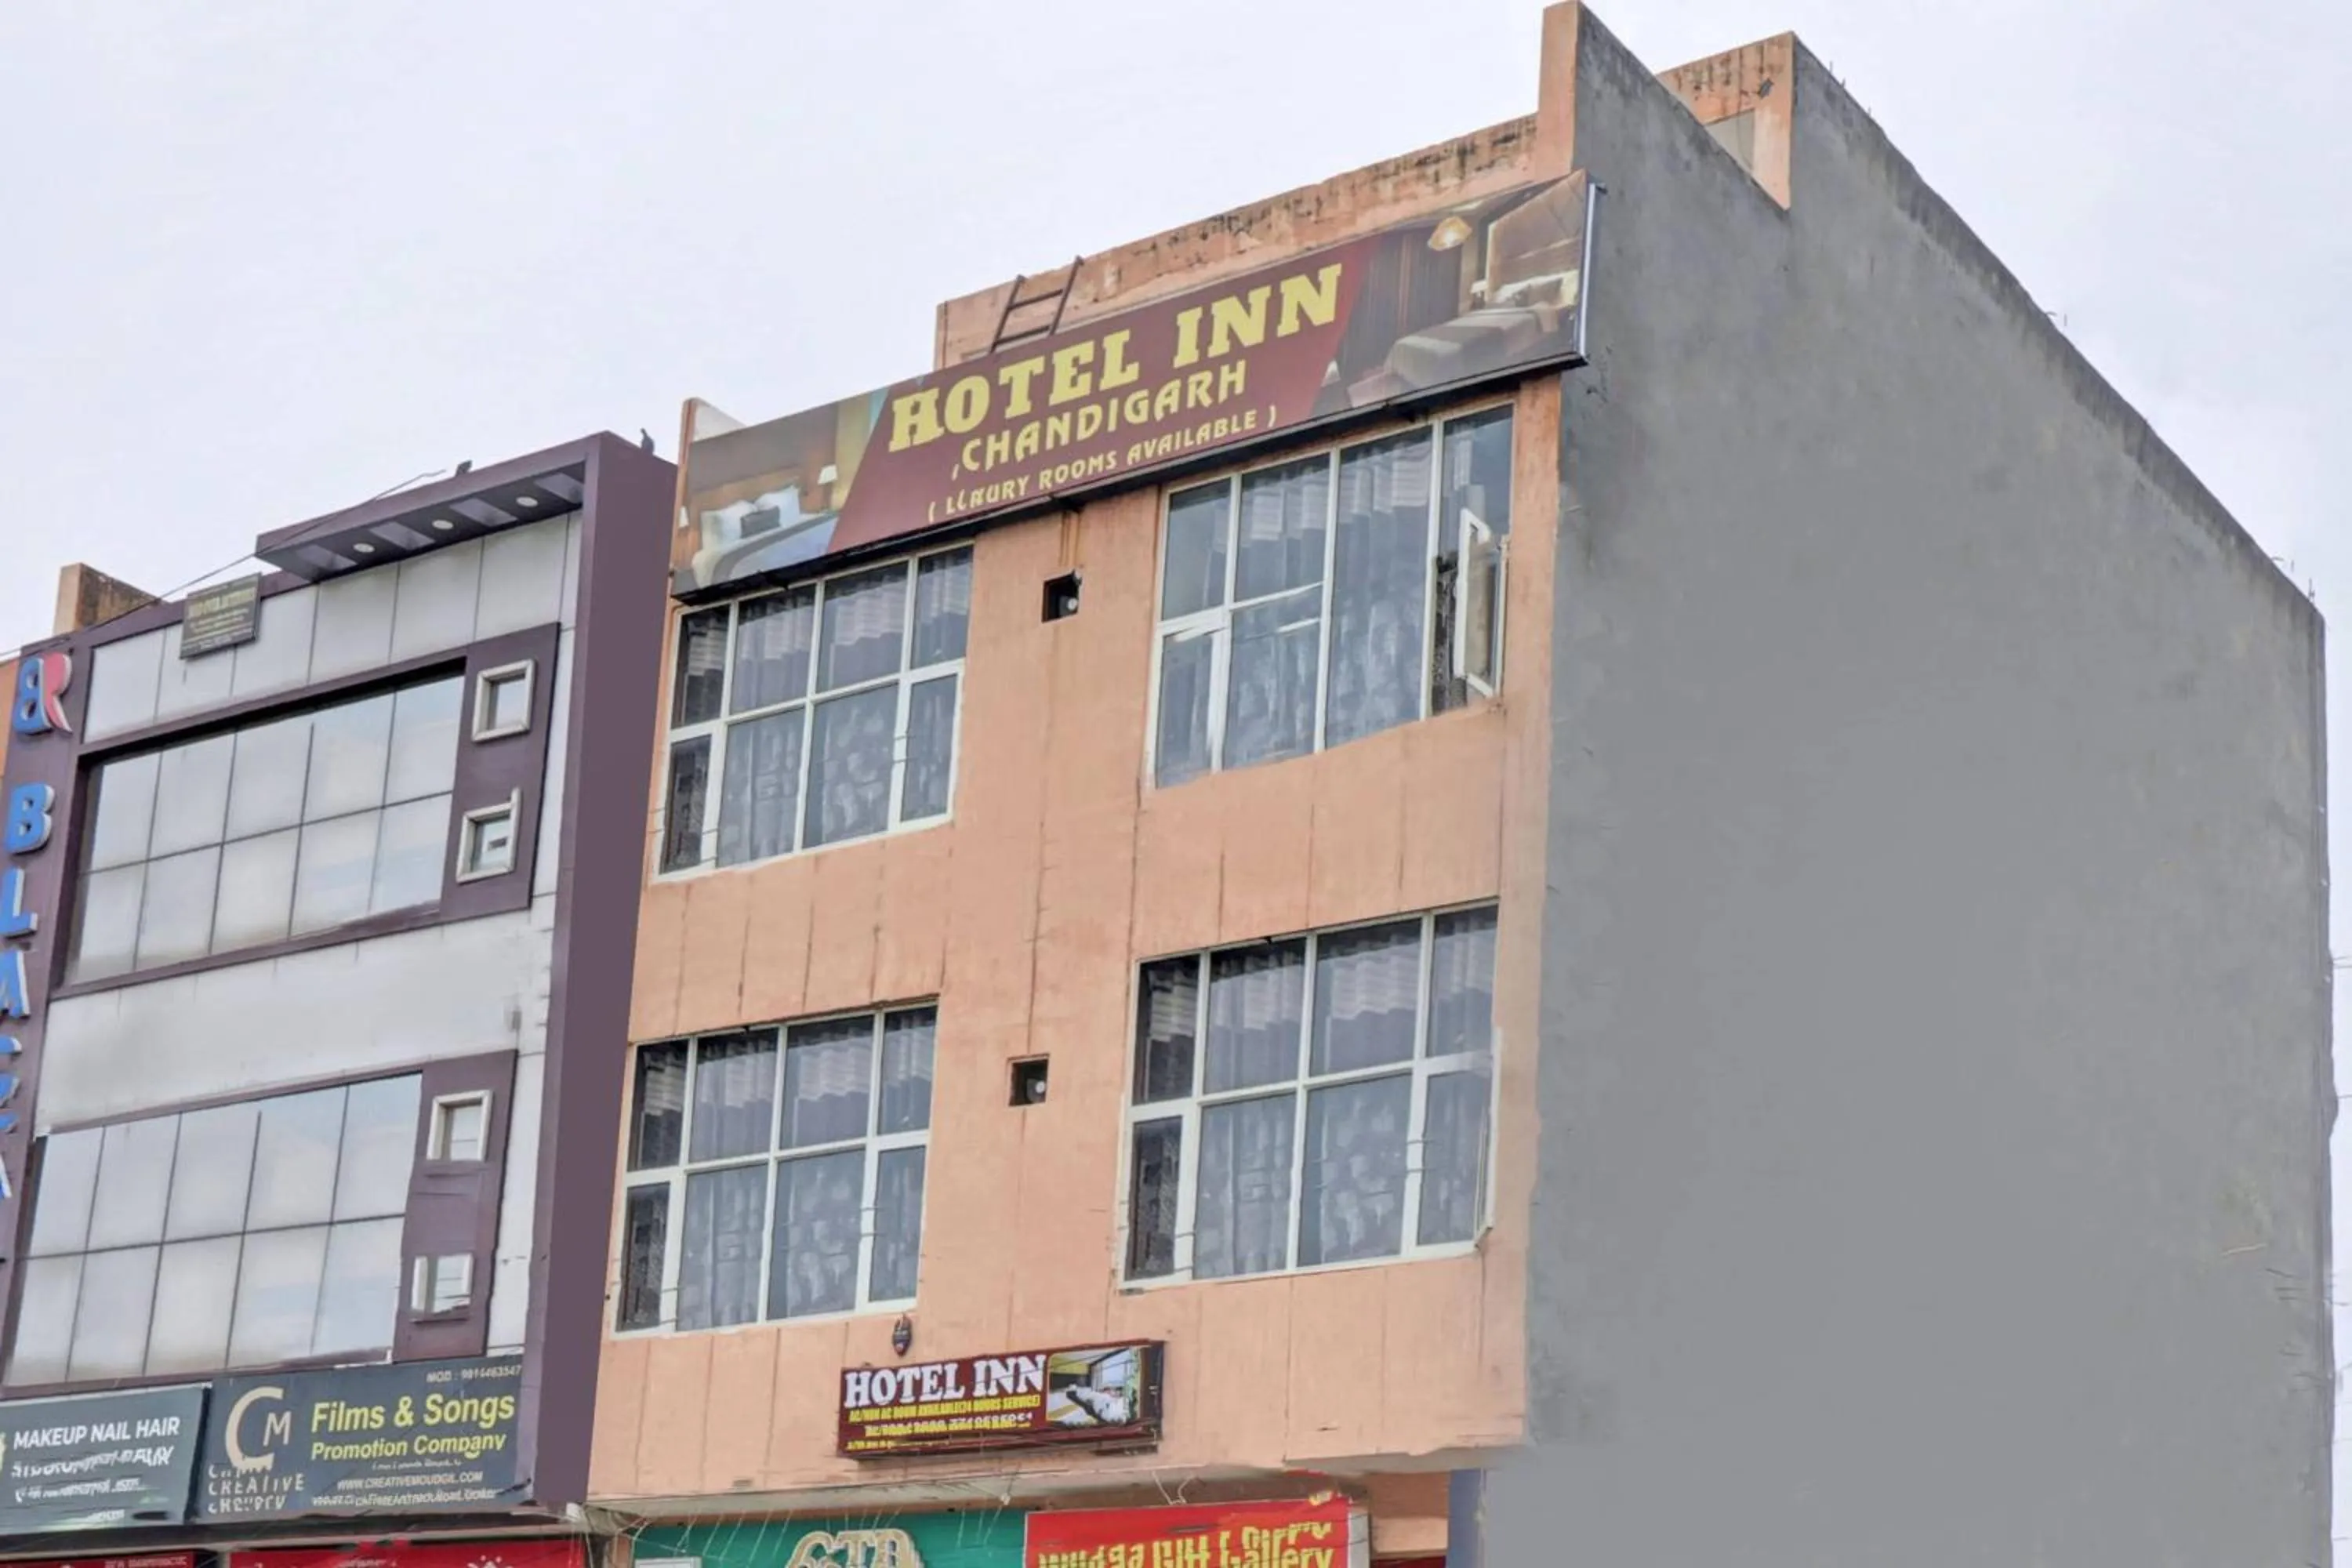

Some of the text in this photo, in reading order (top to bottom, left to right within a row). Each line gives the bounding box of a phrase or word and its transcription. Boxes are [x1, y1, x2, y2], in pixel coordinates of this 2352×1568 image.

[888, 263, 1342, 452] HOTEL INN
[1039, 450, 1117, 490] ROOMS
[1127, 409, 1258, 466] AVAILABLE
[844, 1354, 1047, 1409] HOTEL INN
[13, 1416, 181, 1450] MAKEUP NAIL HAIR
[311, 1392, 516, 1432] Films & Songs
[311, 1432, 507, 1461] Promotion Company
